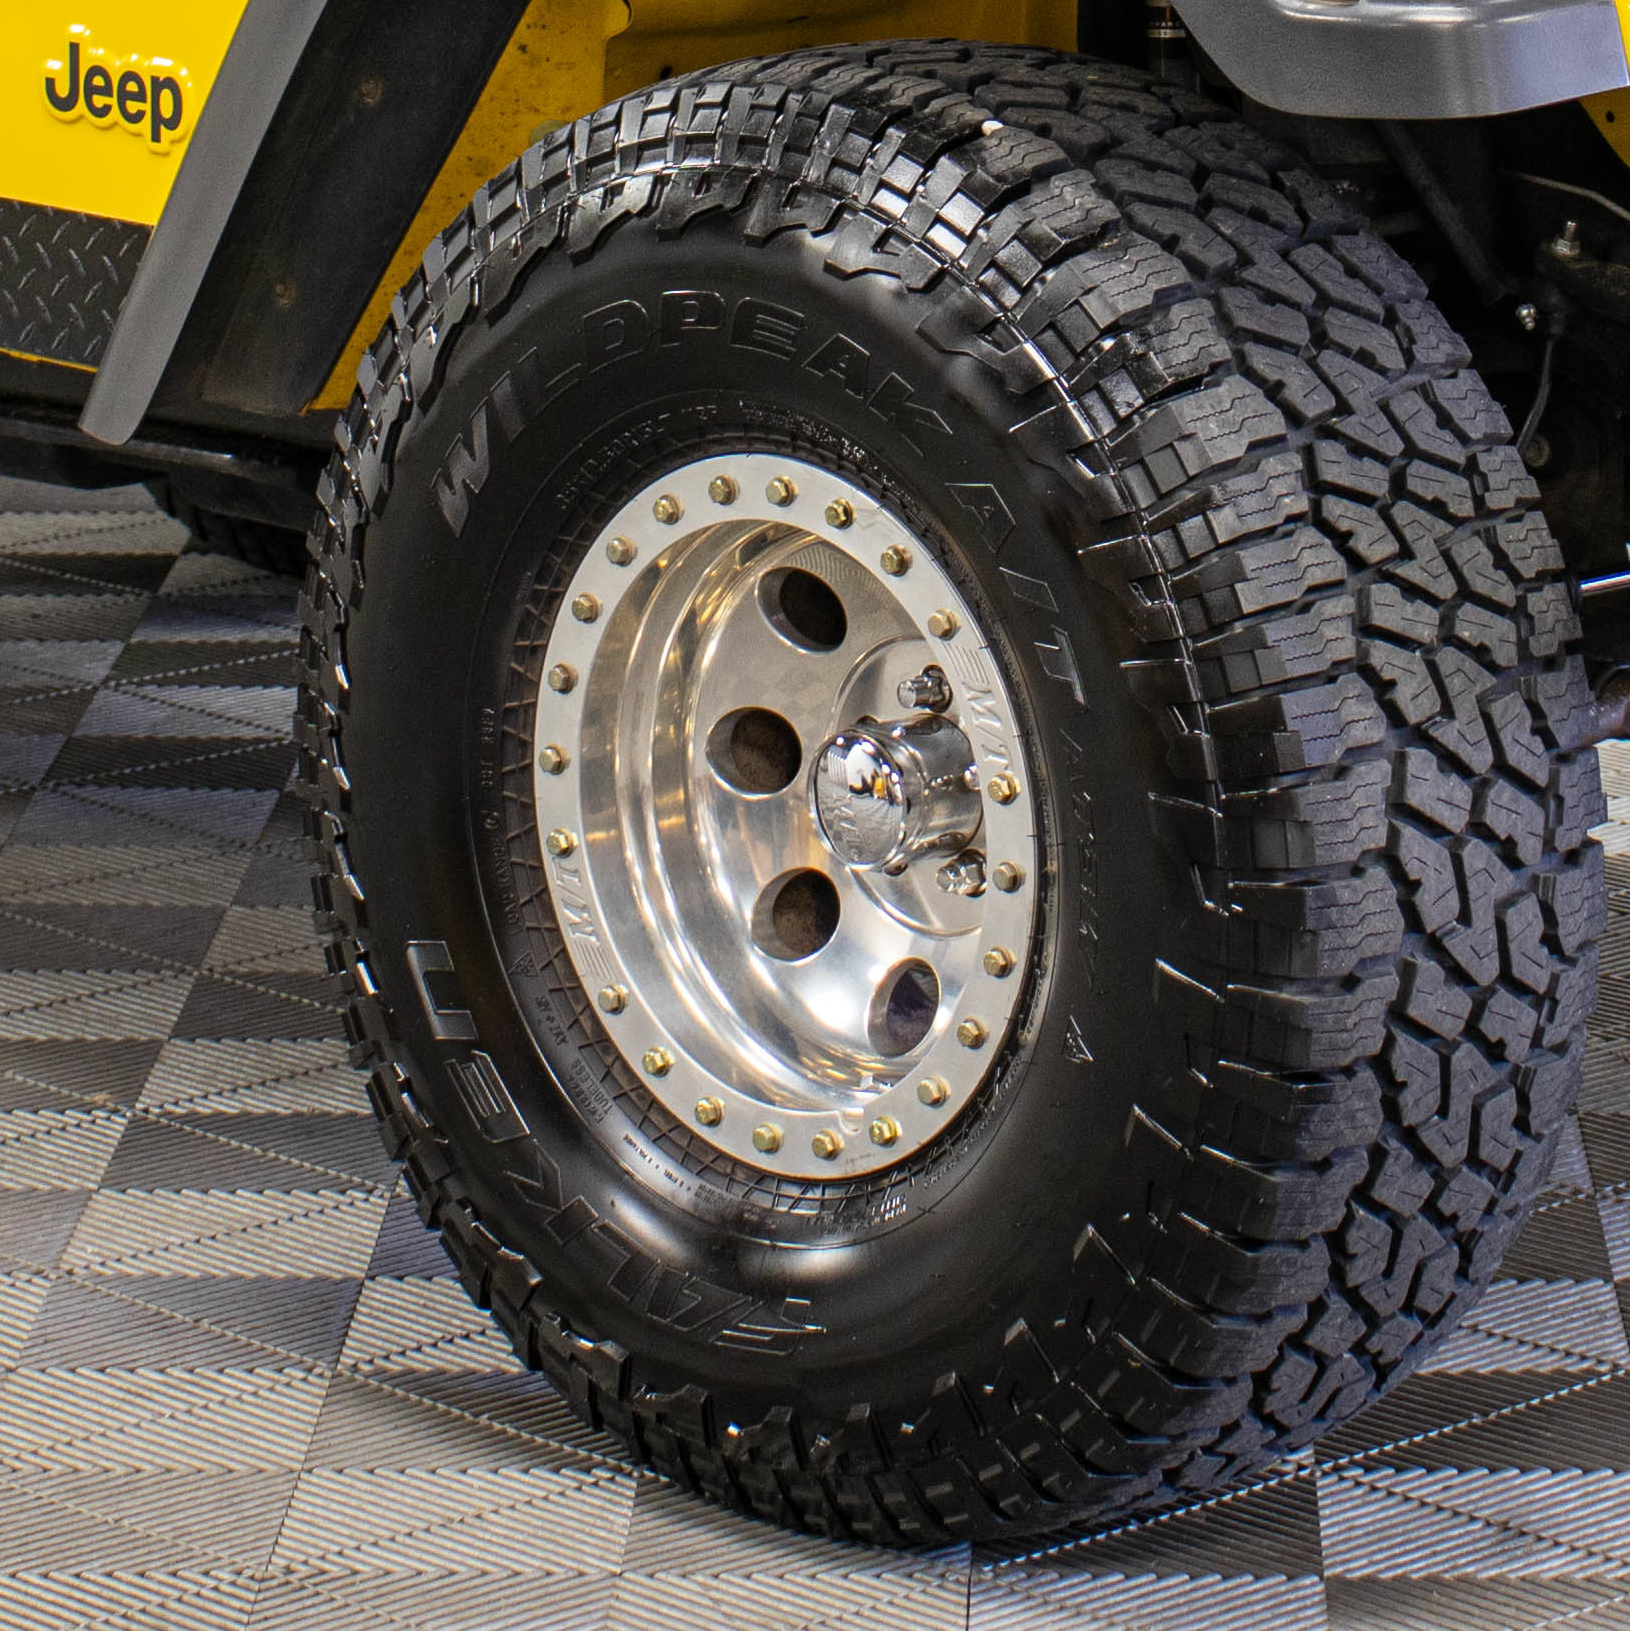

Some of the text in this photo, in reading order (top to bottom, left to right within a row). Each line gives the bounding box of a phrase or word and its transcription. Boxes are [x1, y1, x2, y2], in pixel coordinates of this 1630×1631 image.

[44, 41, 184, 144] Jeep
[431, 288, 954, 538] WILDPEAK
[550, 855, 601, 946] M/T
[406, 939, 828, 1357] FALKEN
